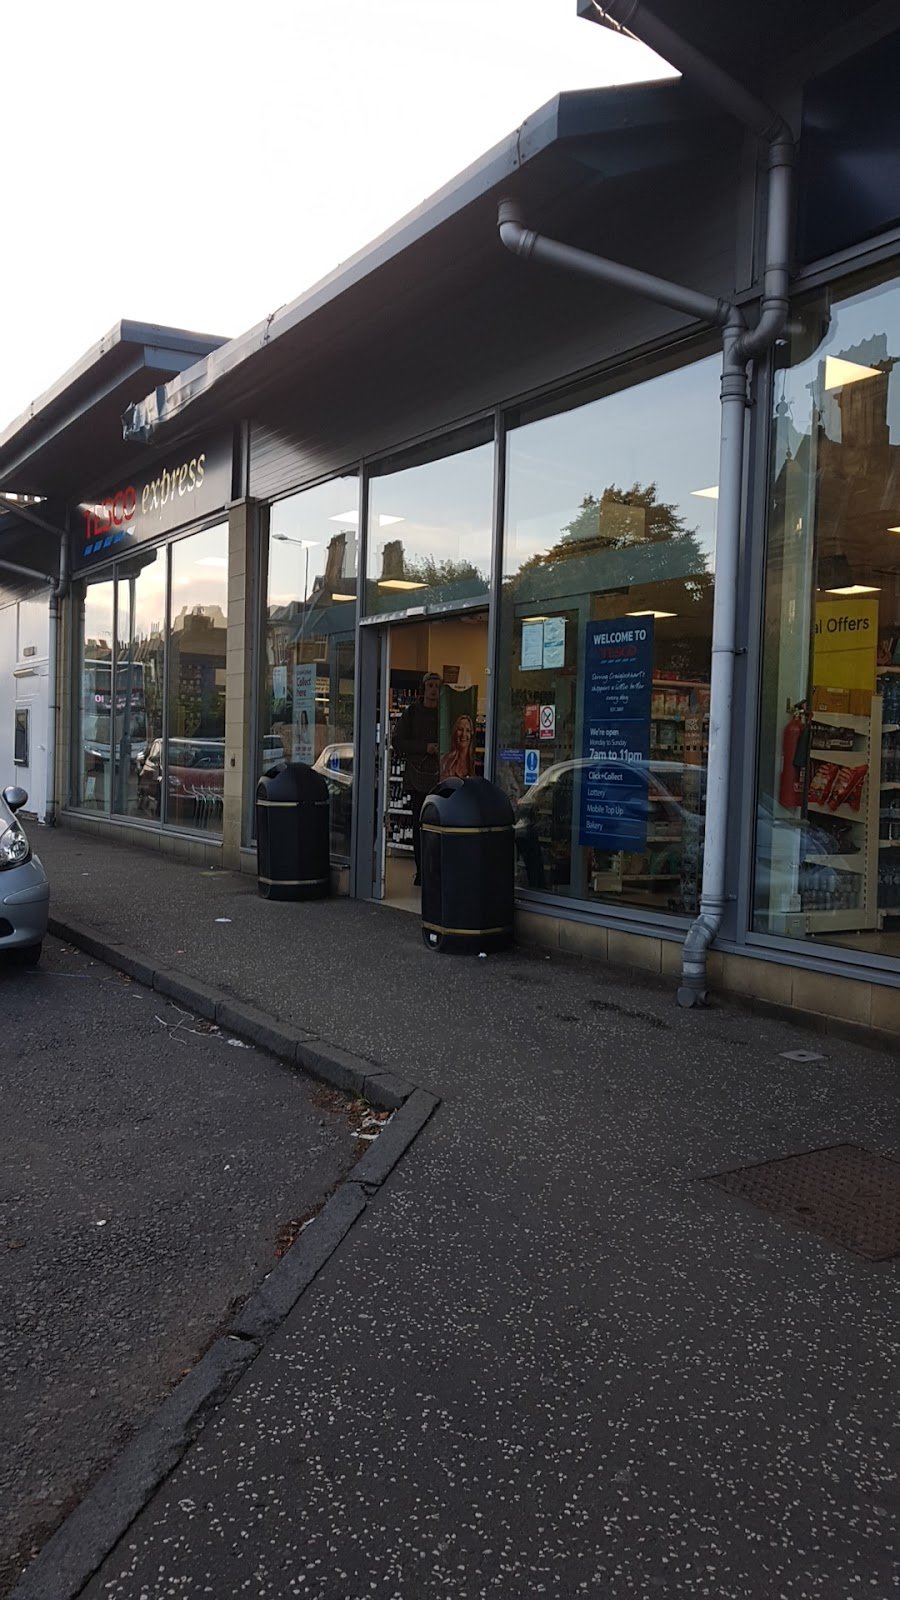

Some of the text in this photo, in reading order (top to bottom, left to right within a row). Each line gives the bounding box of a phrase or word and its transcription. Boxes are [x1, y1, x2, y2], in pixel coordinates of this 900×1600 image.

[80, 453, 205, 539] TESCO express
[827, 616, 869, 633] Offers
[594, 629, 646, 645] WELCOME TO
[590, 728, 620, 738] We're open
[612, 739, 628, 748] Sunday
[589, 748, 643, 764] 7am to 11pm
[587, 787, 606, 799] Lottery
[587, 804, 624, 817] Mobile Top Up
[585, 821, 603, 831] Bakery
